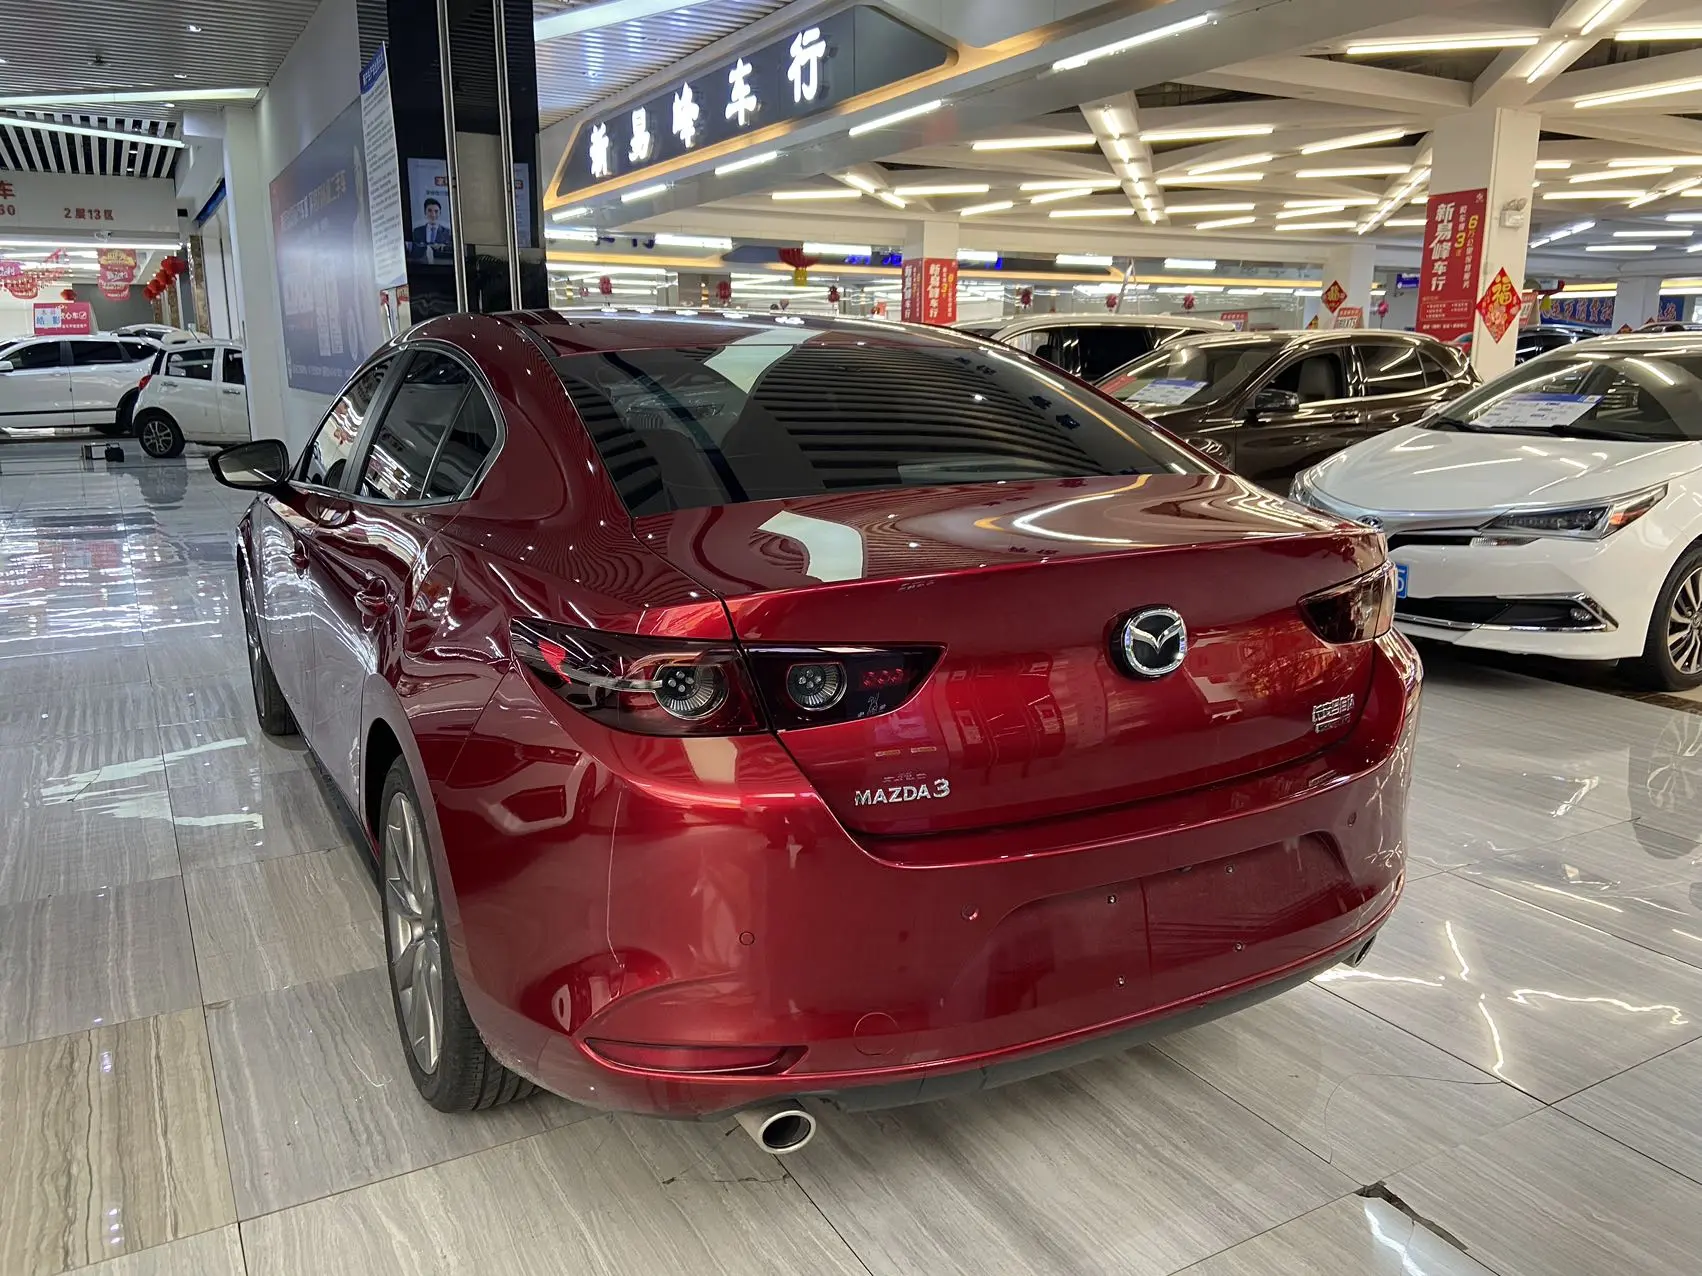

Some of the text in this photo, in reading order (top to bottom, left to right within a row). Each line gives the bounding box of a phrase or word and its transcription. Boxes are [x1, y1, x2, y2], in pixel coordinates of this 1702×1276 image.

[589, 27, 826, 178] 新易峰车行
[1429, 202, 1455, 292] 新易峰车行
[1491, 274, 1512, 305] 福
